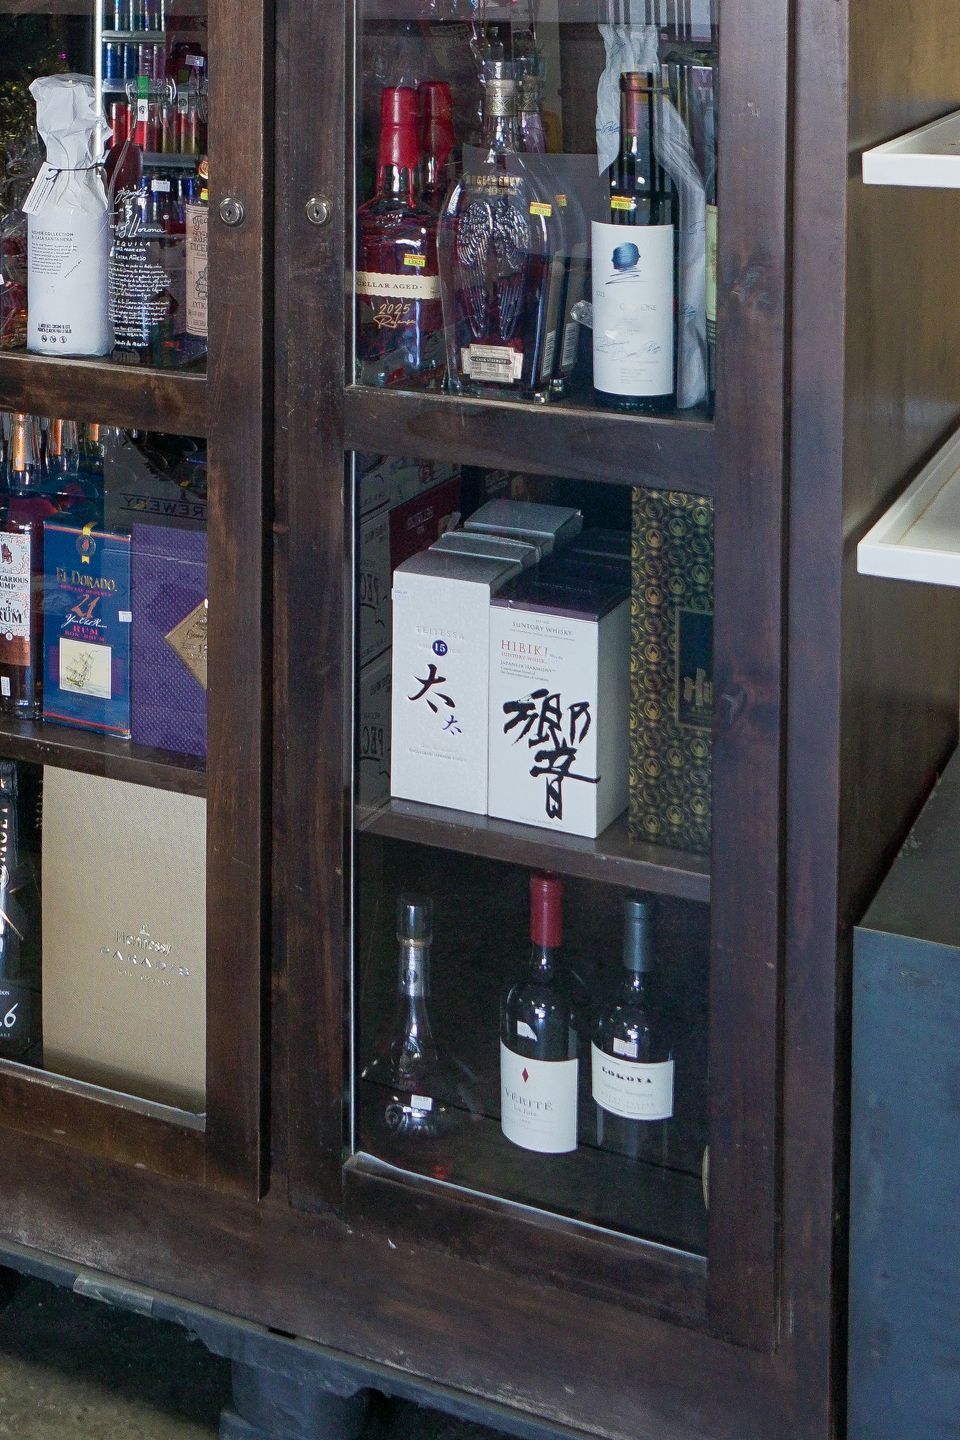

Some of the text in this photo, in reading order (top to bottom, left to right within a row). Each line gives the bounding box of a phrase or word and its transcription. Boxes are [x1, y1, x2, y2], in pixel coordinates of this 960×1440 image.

[392, 282, 419, 291] AGED
[378, 302, 411, 315] 2025
[71, 593, 101, 619] 21
[512, 621, 573, 636] SUNTORY WHISKY
[435, 643, 446, 653] 15
